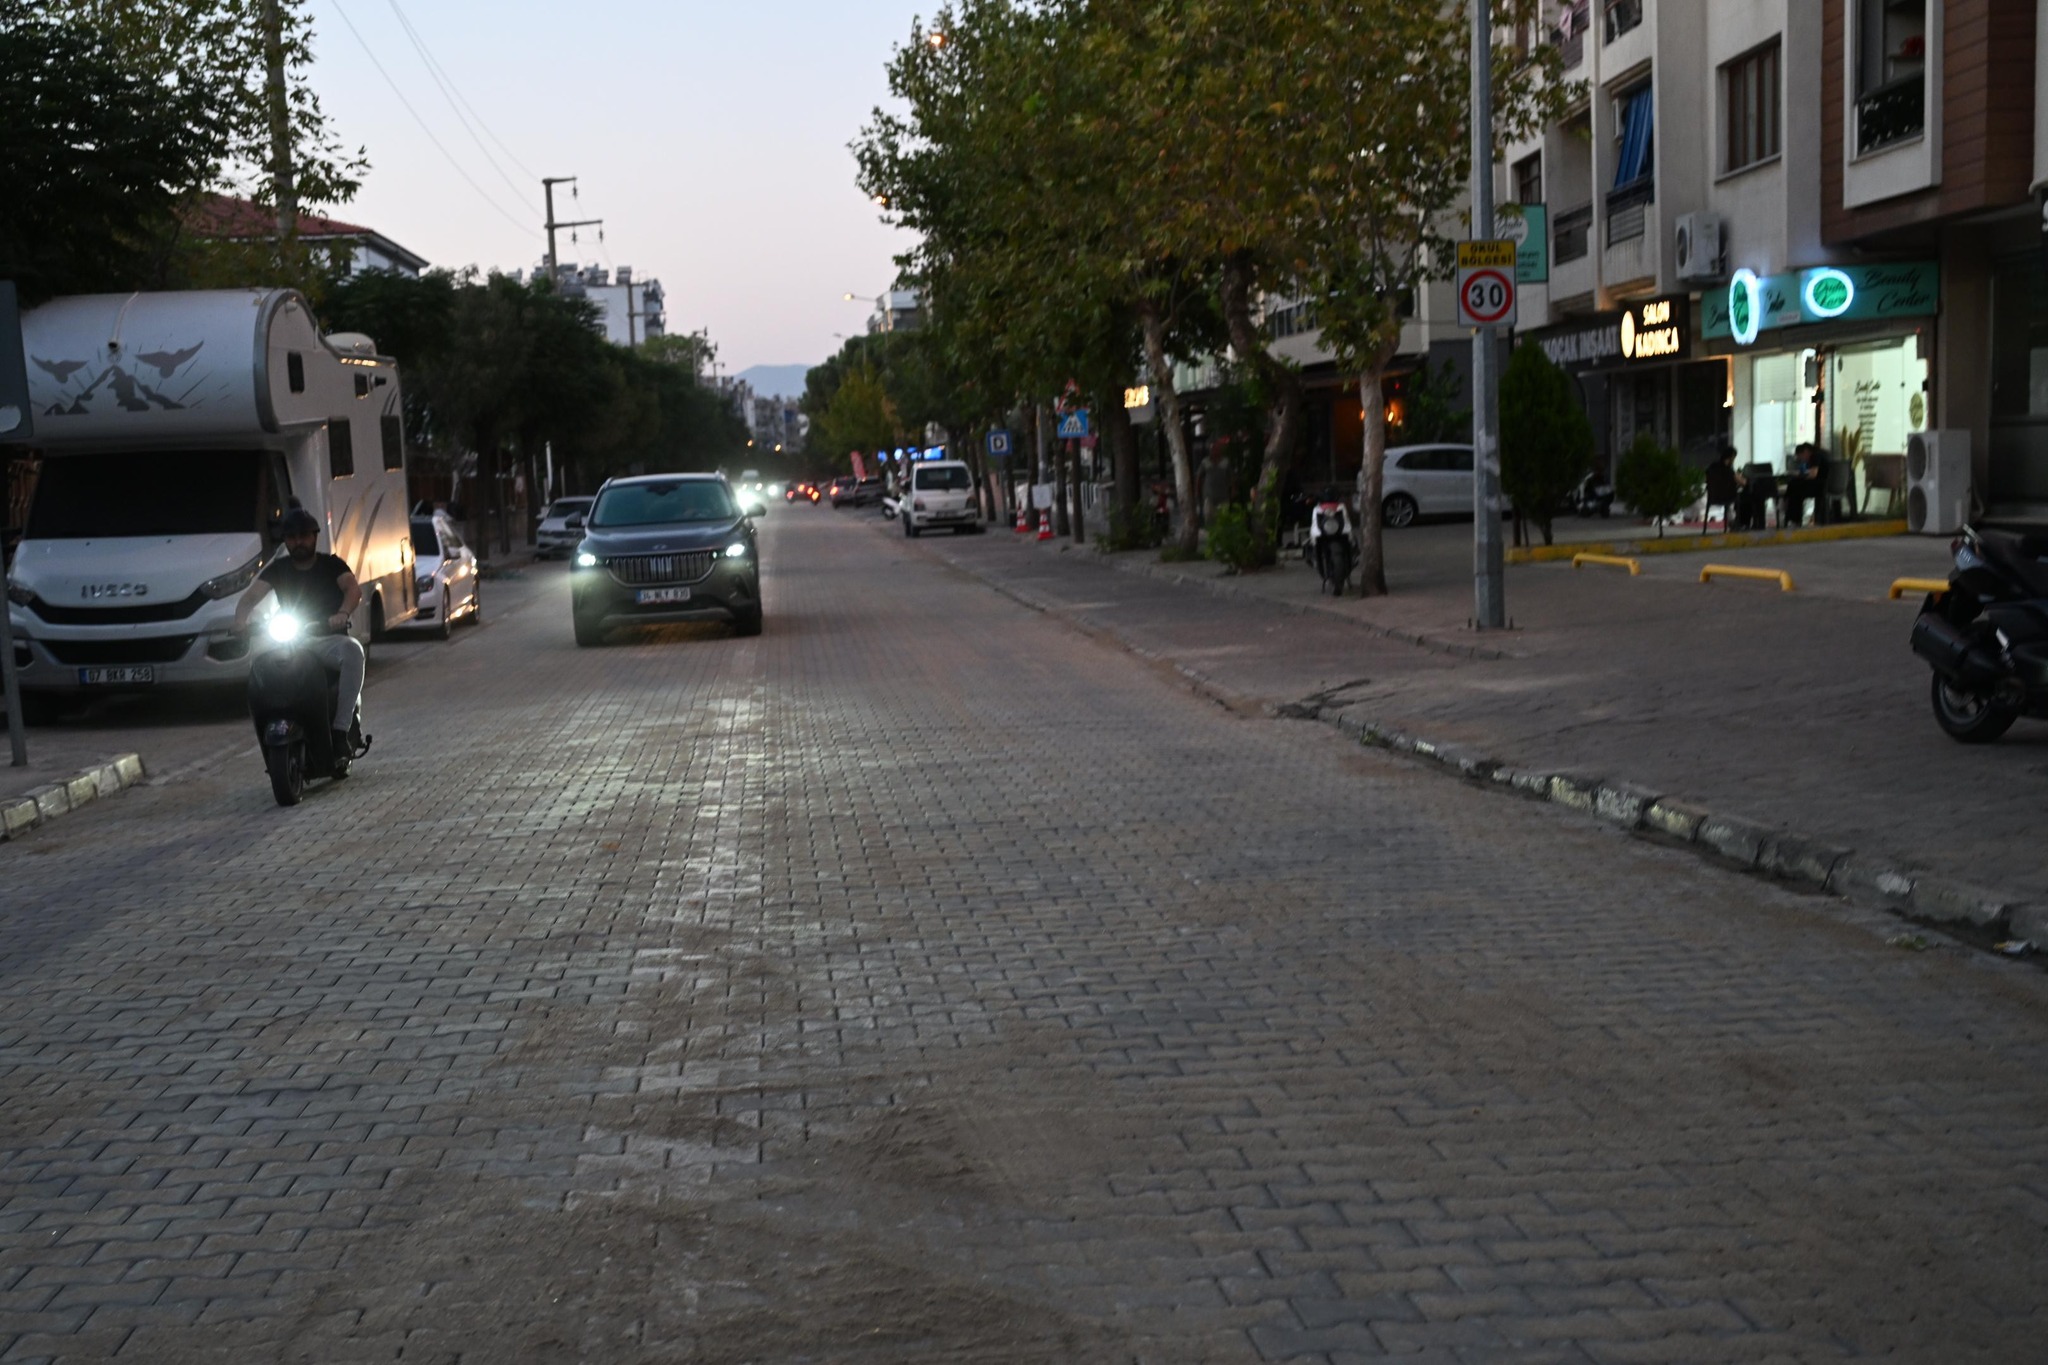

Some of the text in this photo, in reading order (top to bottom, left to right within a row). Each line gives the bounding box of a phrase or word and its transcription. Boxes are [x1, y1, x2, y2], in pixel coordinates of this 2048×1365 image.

[1470, 243, 1500, 253] OKUL
[1864, 268, 1921, 291] Beauty
[1471, 284, 1503, 309] 30
[1877, 290, 1930, 313] Center
[1643, 300, 1670, 326] SALON
[81, 583, 148, 598] IVECO
